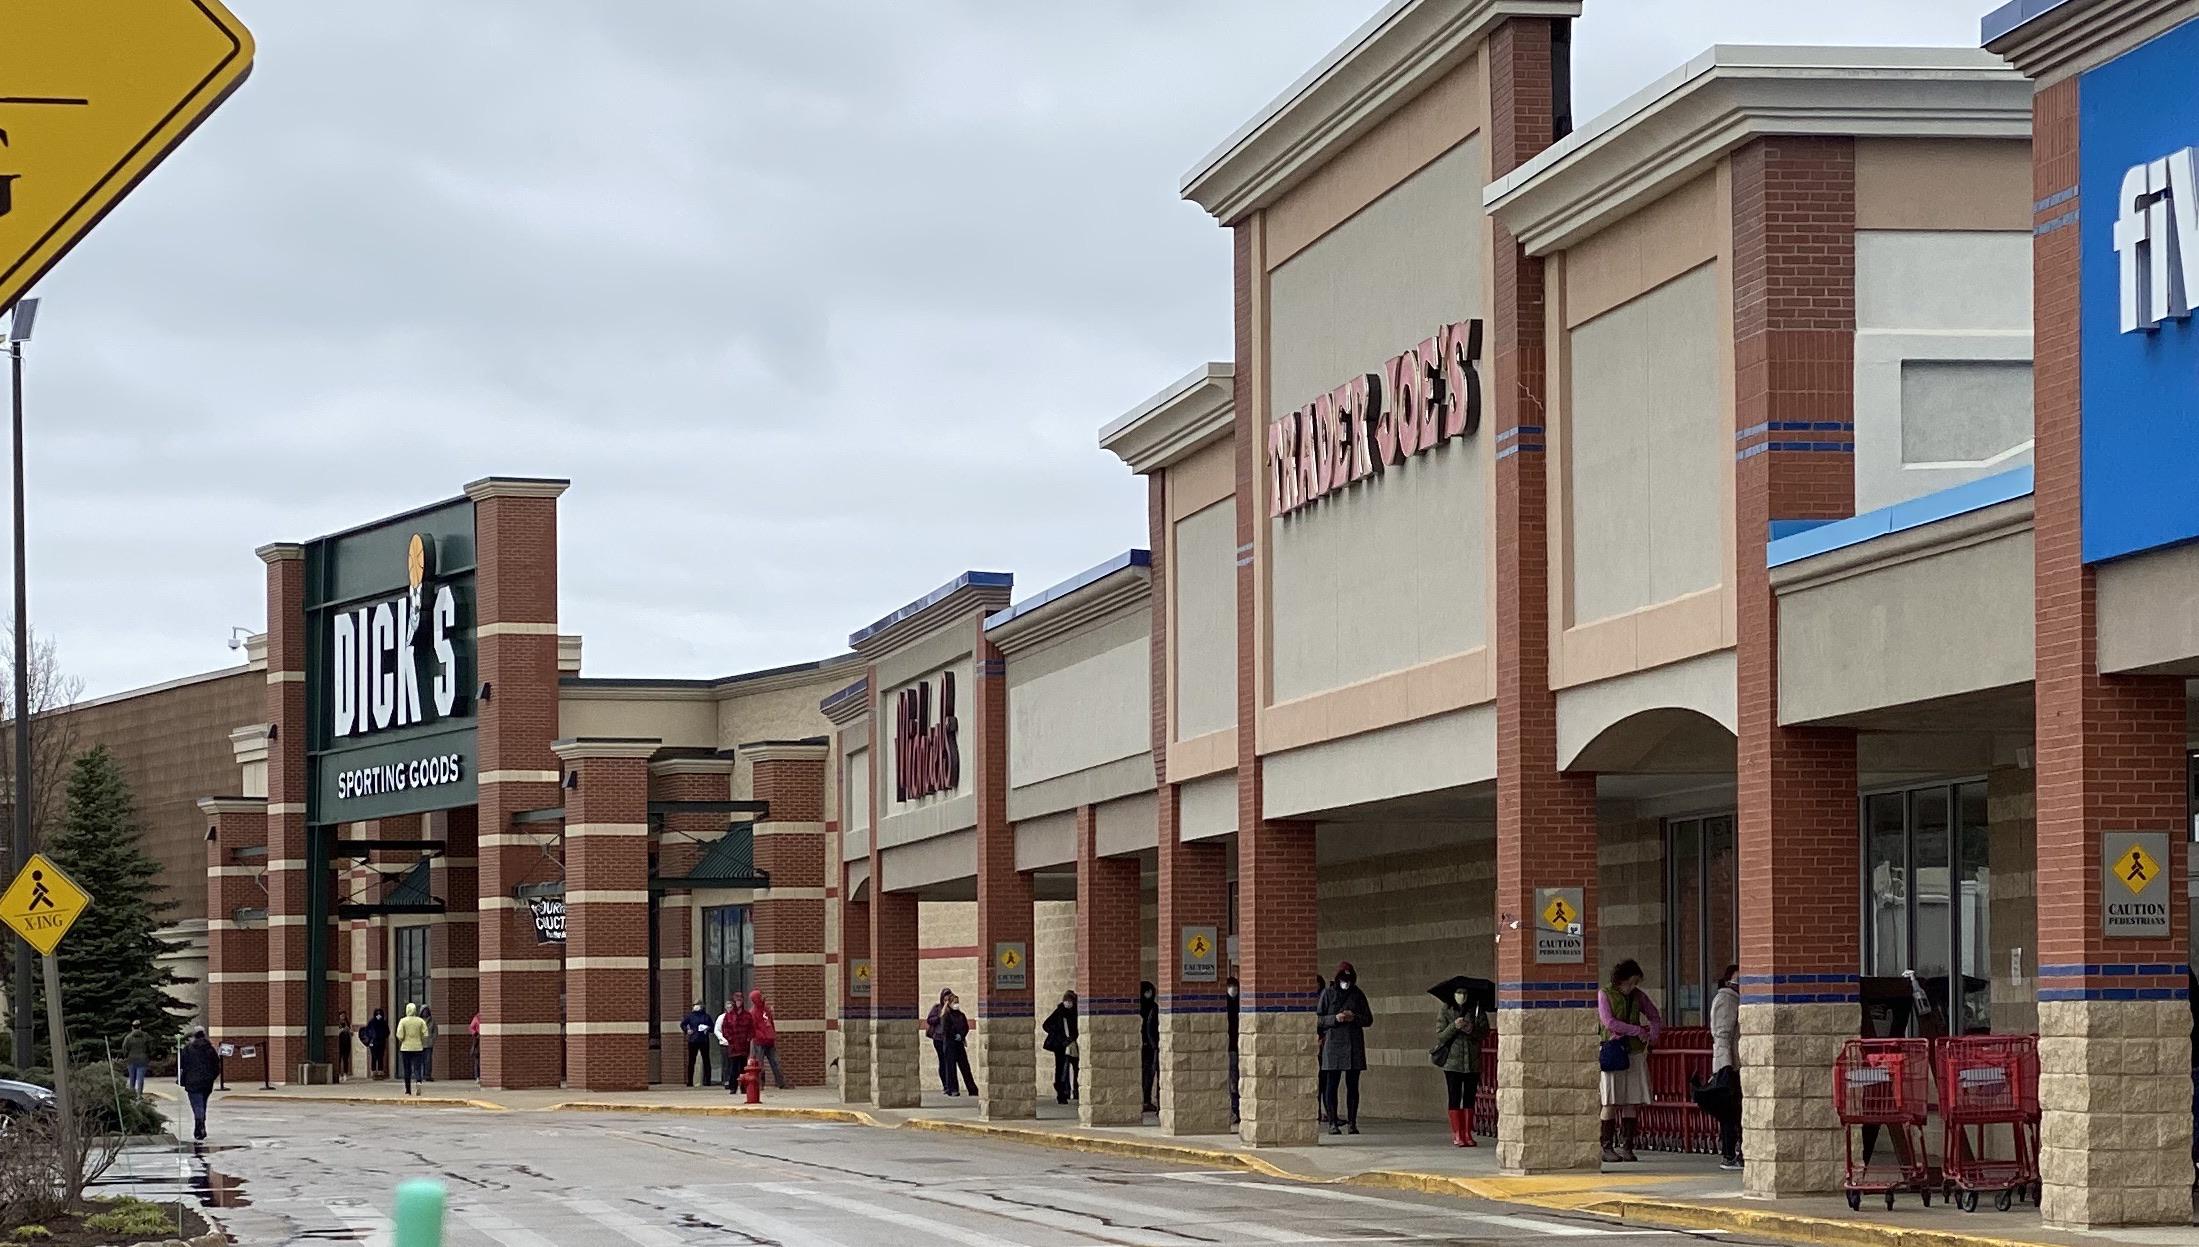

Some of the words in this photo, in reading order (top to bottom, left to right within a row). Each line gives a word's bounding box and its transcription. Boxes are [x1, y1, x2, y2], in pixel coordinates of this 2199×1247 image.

[1267, 373, 1384, 518] TRADER
[1375, 318, 1483, 467] JOE'S
[334, 580, 456, 737] DICK'S
[338, 763, 405, 799] SPORTING
[410, 753, 459, 788] GOODS
[2108, 903, 2165, 915] CAUTION
[2108, 917, 2166, 926] PEDESTRIANS
[1539, 939, 1581, 949] CAUTION
